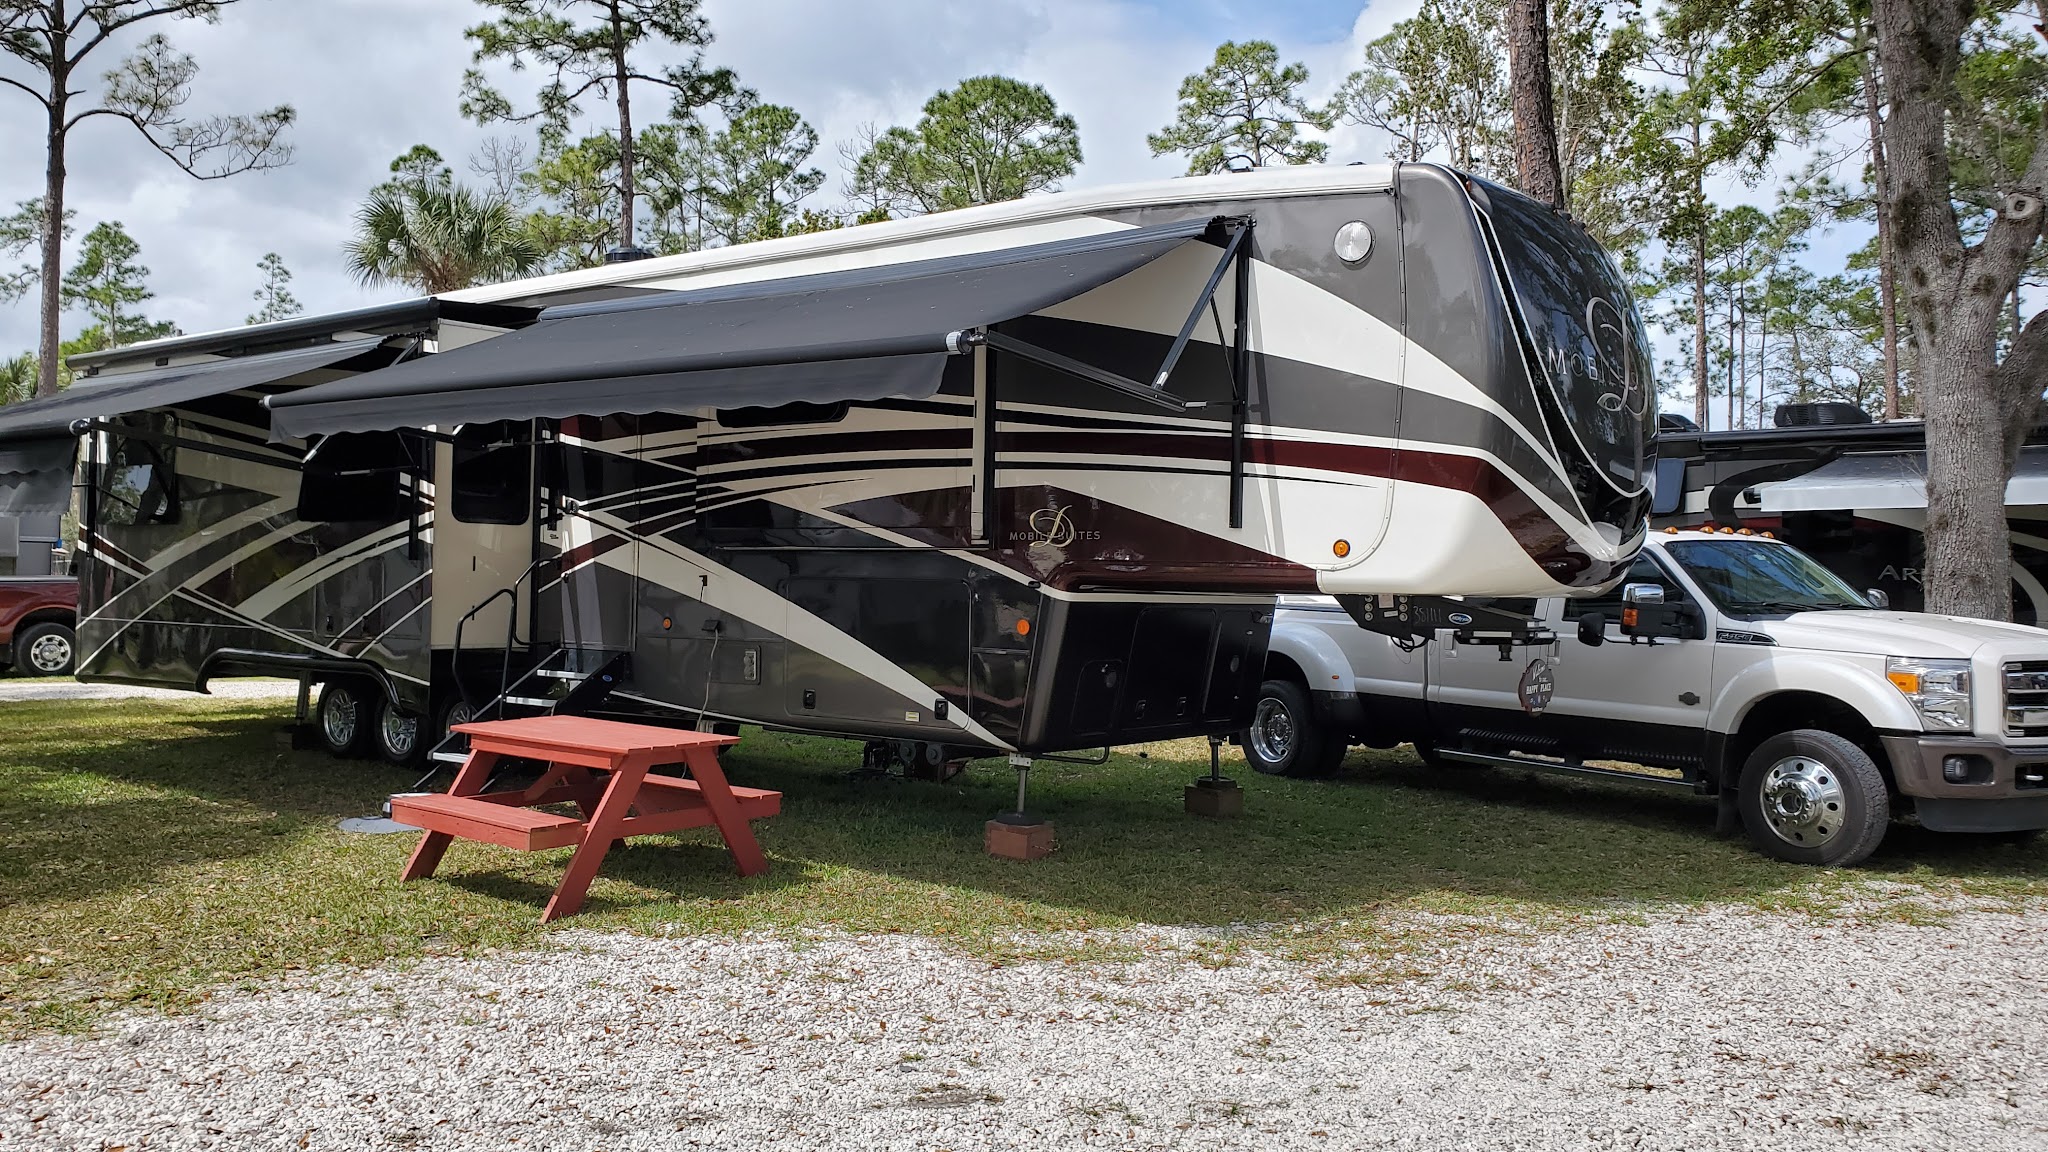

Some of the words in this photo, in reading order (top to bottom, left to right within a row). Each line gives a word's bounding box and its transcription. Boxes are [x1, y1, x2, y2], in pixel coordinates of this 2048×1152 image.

[1009, 531, 1053, 541] MOBILE
[1057, 531, 1101, 540] SUITES
[1526, 684, 1539, 695] HAPPY
[1540, 682, 1552, 693] PLACE
